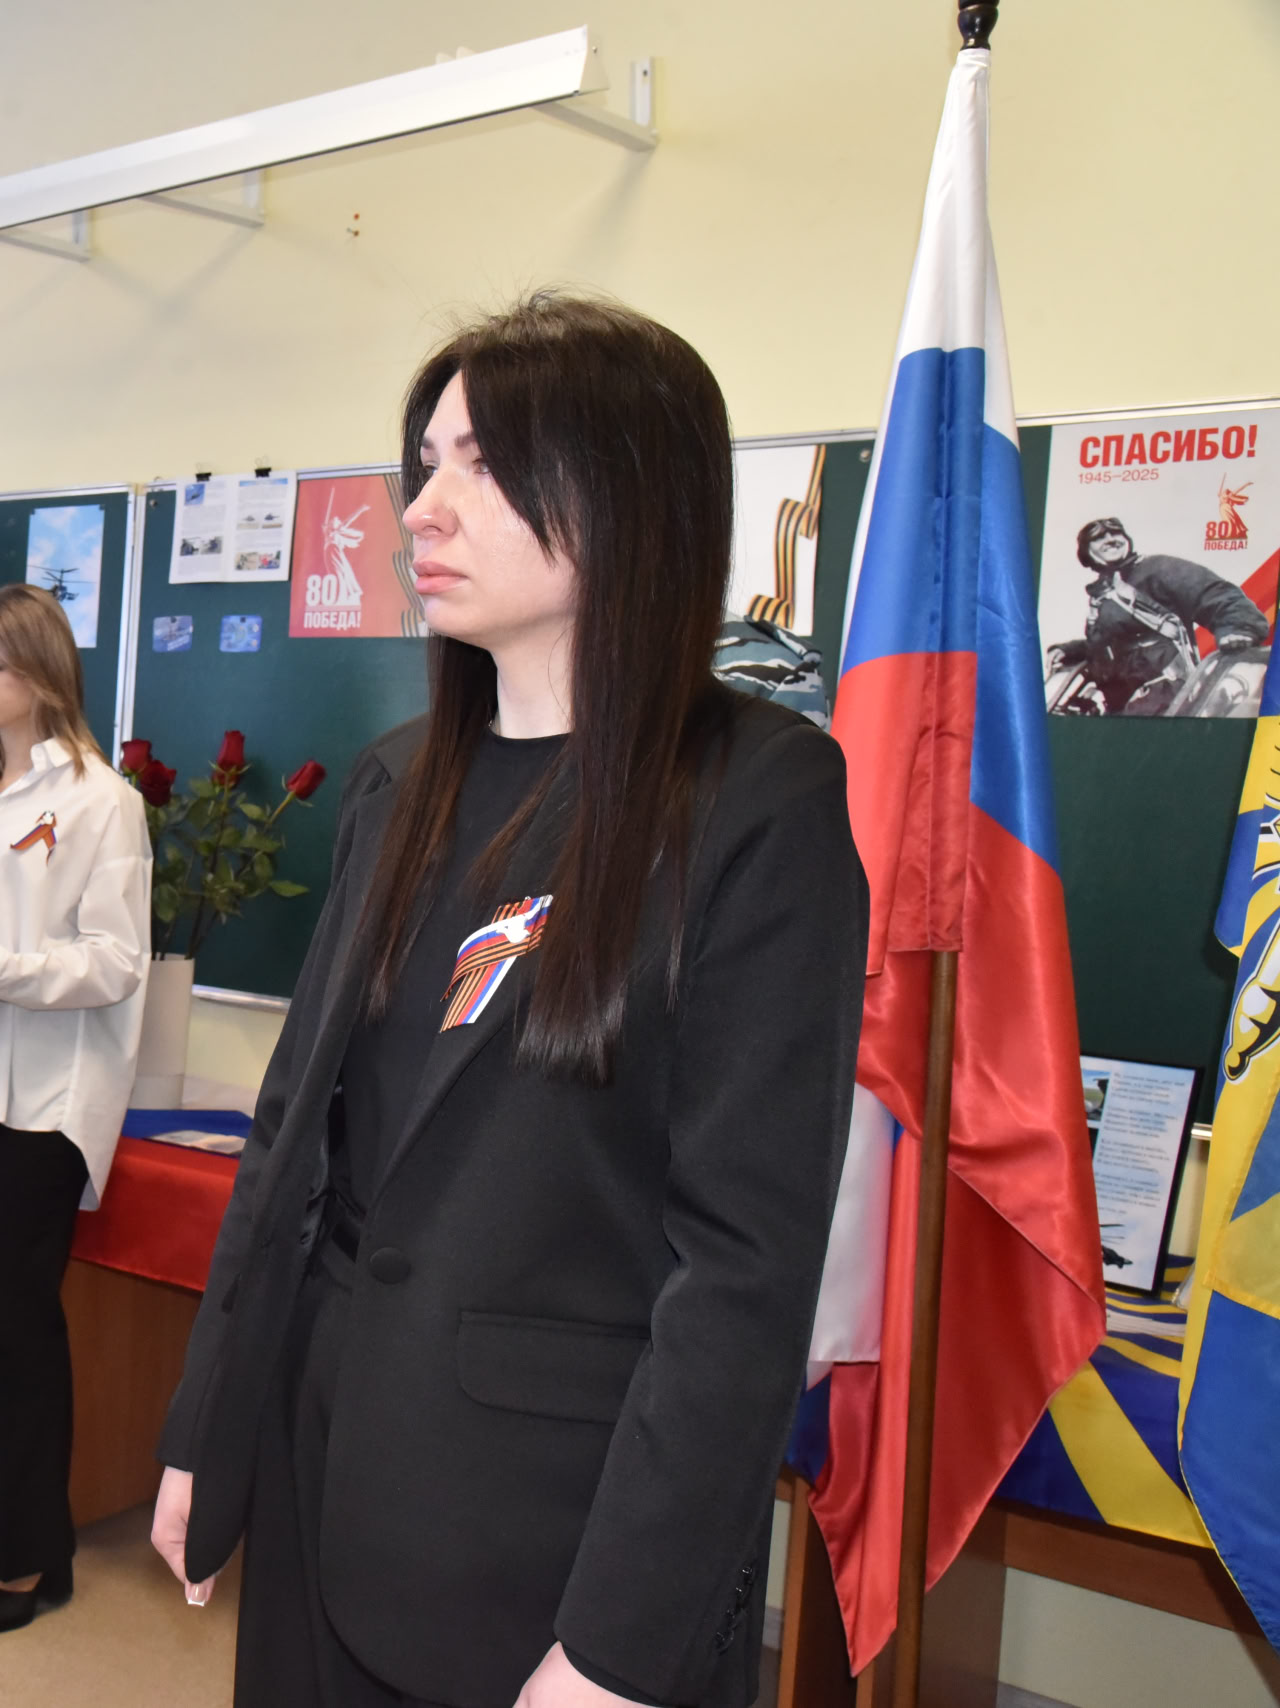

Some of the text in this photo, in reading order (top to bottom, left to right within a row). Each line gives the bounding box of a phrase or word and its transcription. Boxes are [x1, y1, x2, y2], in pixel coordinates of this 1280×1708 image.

[1079, 424, 1258, 468] СПАСИБО!
[1206, 521, 1228, 539] 80
[1204, 539, 1248, 551] ПОБЕДА!
[305, 574, 339, 606] 80
[304, 611, 361, 630] ПОБЕДА!
